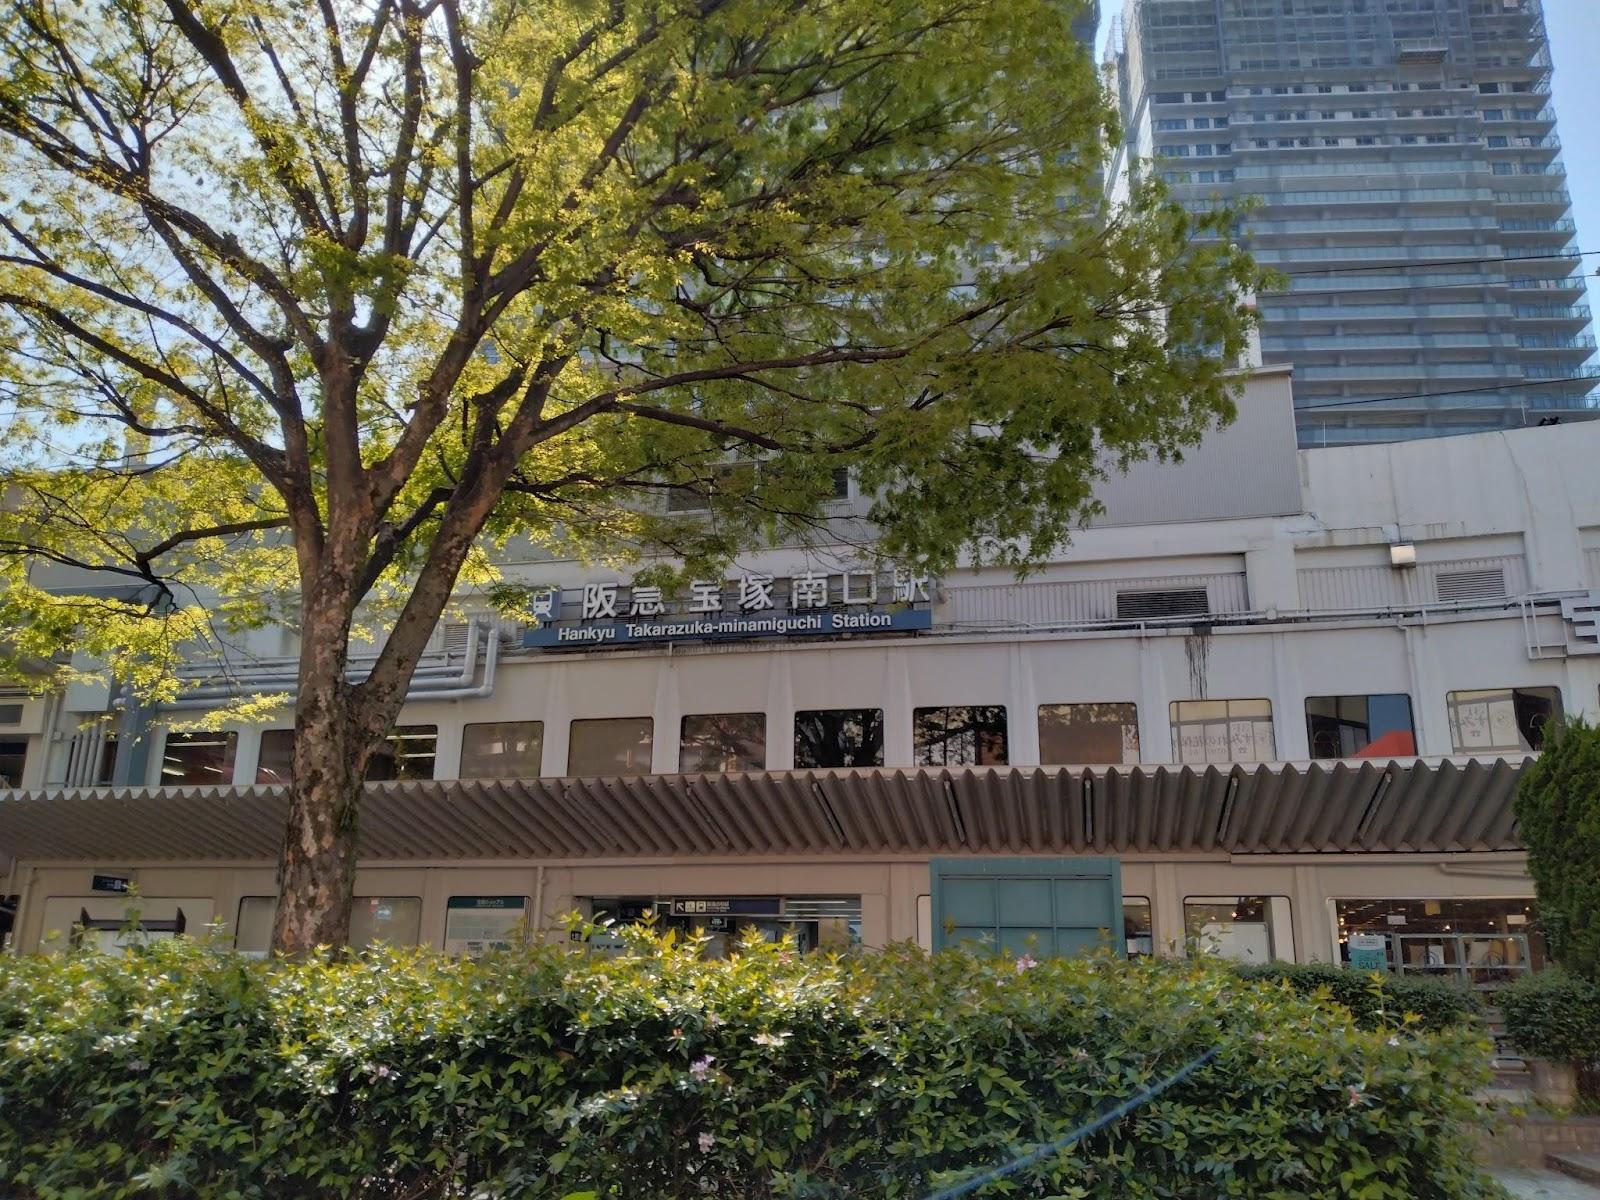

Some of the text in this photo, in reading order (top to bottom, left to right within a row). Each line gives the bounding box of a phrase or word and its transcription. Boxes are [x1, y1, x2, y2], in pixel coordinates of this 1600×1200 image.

[558, 613, 891, 642] Hankyu Takarazuka-minamiguchi Station
